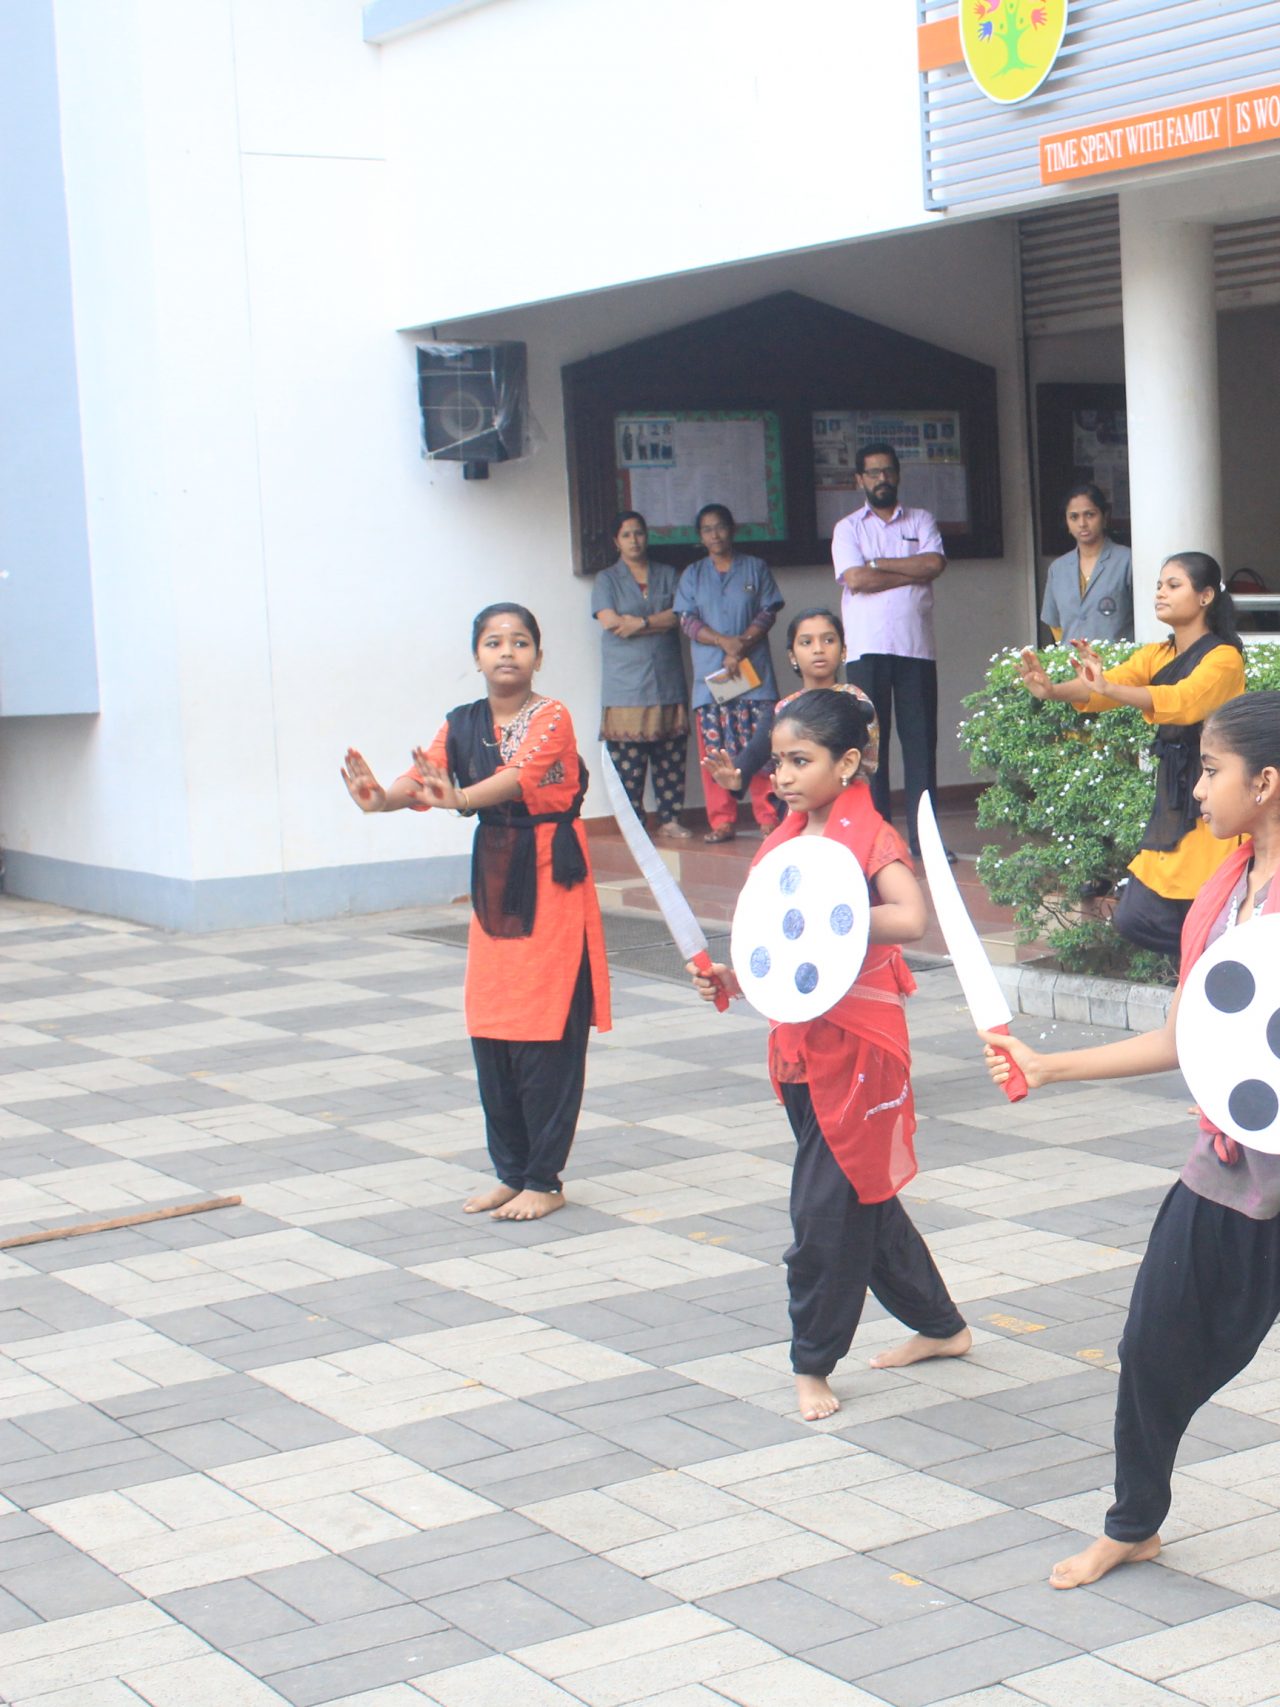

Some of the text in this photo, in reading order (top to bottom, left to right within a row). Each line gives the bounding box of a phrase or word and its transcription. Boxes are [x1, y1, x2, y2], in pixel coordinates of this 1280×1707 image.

[1044, 138, 1079, 173] TIME
[1080, 128, 1124, 165] SPENT
[1125, 119, 1164, 155] WITH
[1166, 106, 1222, 148] FAMILY
[1236, 101, 1251, 133] IS
